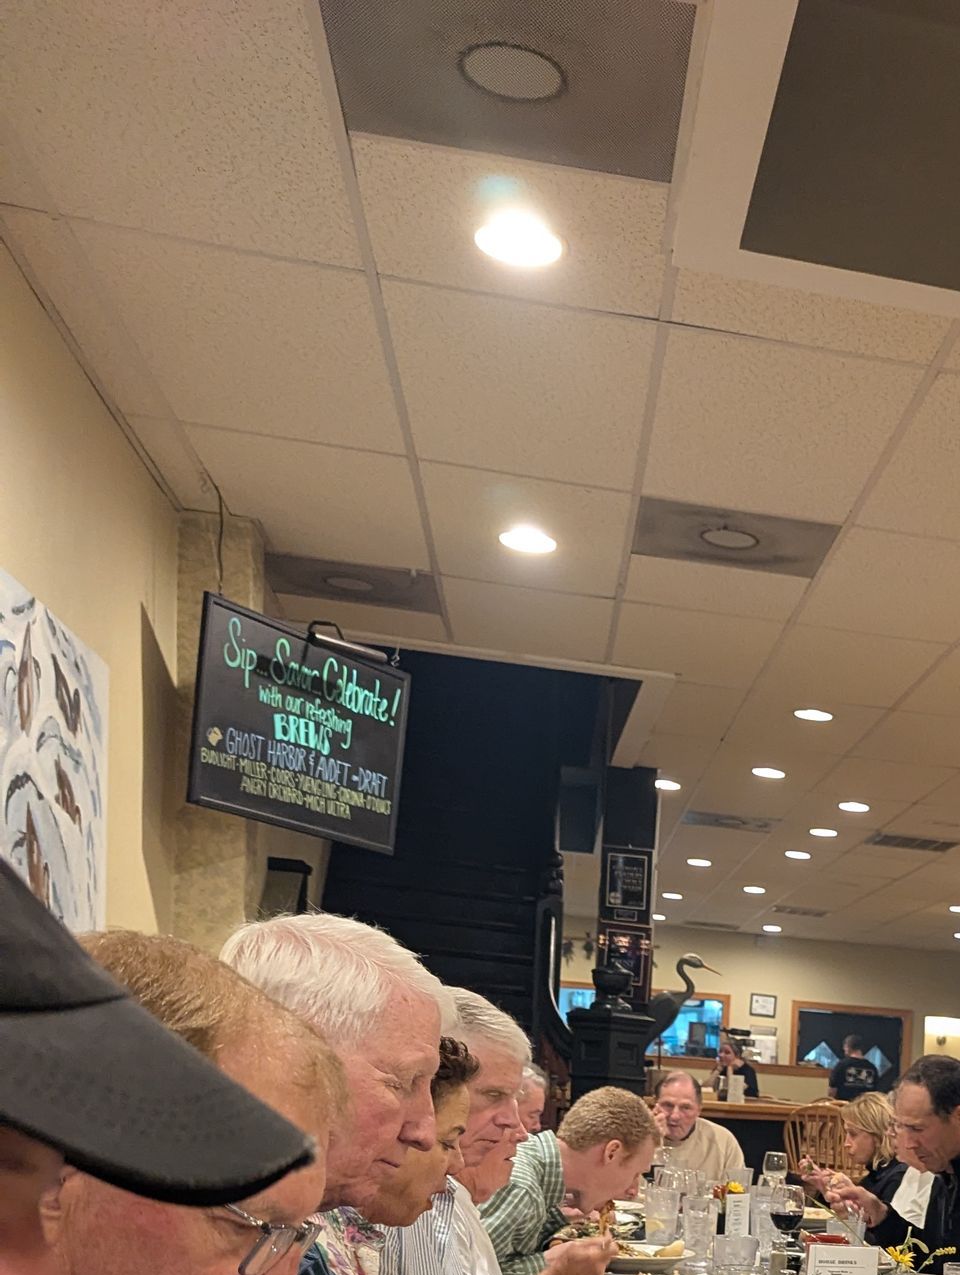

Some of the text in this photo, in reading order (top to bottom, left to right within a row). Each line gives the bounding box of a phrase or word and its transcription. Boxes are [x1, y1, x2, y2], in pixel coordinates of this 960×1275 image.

[258, 684, 283, 708] with
[284, 695, 304, 714] our
[322, 657, 401, 727] Celebrate!
[226, 727, 266, 760] GHOST
[267, 740, 307, 772] HARBOR
[273, 713, 333, 755] BREWS
